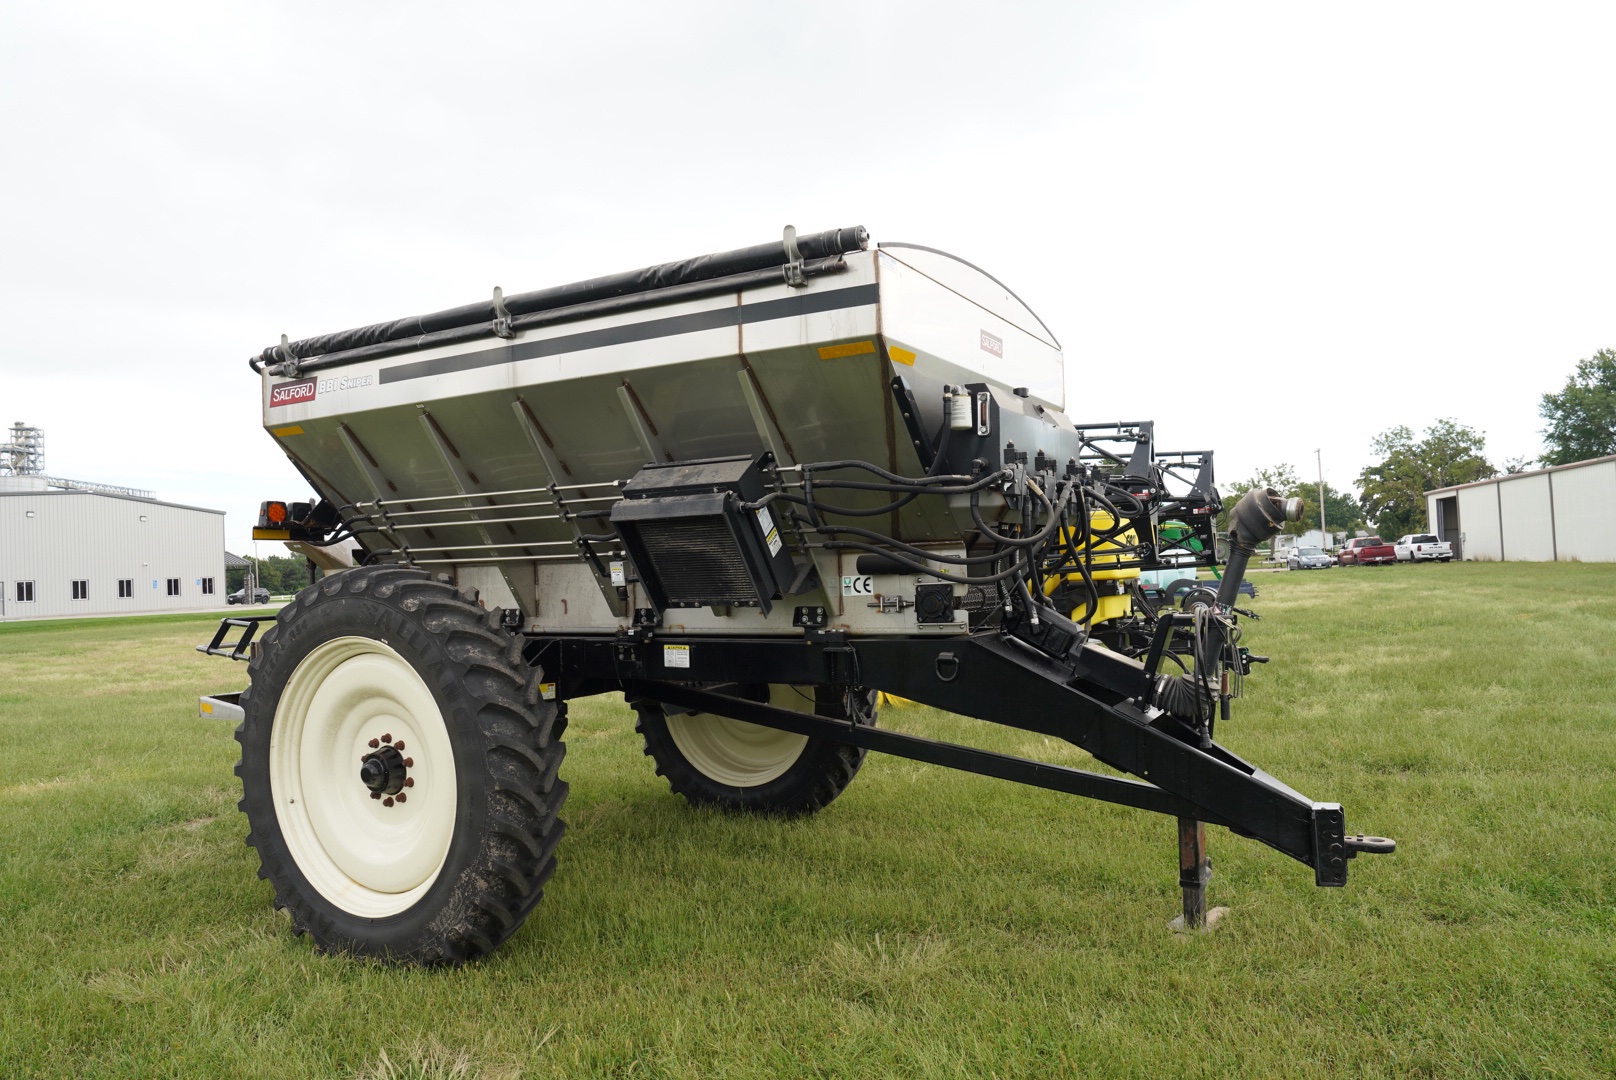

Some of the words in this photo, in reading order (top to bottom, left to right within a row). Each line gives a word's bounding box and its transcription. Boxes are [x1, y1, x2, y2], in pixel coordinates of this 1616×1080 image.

[273, 383, 314, 402] SALFORD
[318, 379, 338, 394] BBI
[340, 375, 373, 390] SNIPER
[853, 577, 871, 593] CE
[374, 609, 476, 745] ALLIANCE
